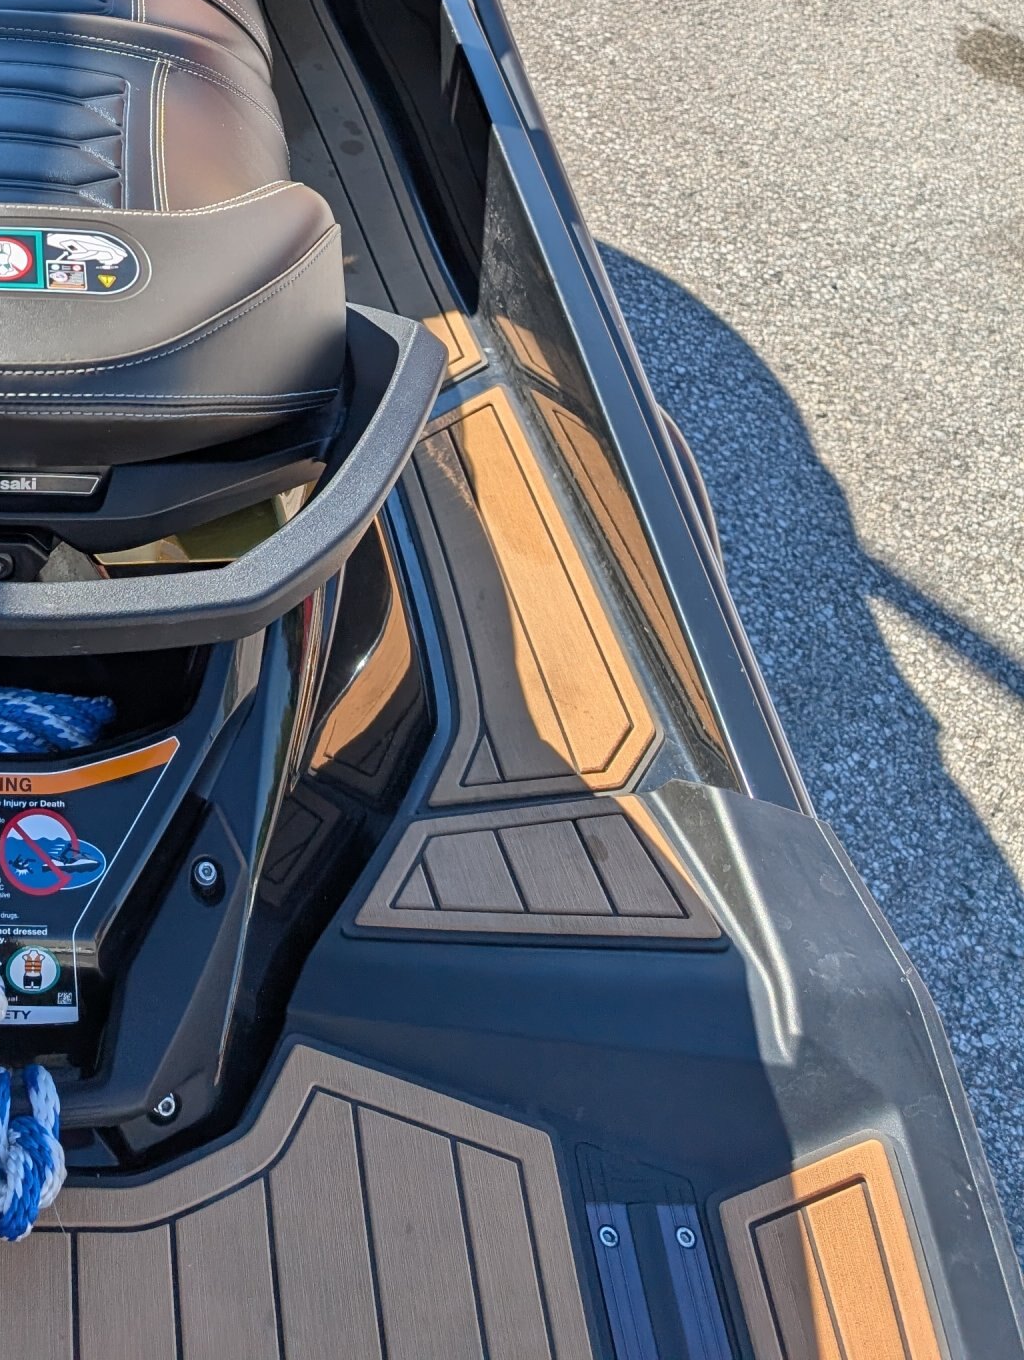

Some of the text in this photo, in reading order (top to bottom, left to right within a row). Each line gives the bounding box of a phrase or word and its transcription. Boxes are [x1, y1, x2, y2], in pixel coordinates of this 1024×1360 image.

[3, 799, 27, 808] Injury
[40, 800, 65, 808] Death
[0, 912, 19, 920] drugs.
[5, 1010, 31, 1019] ETY
